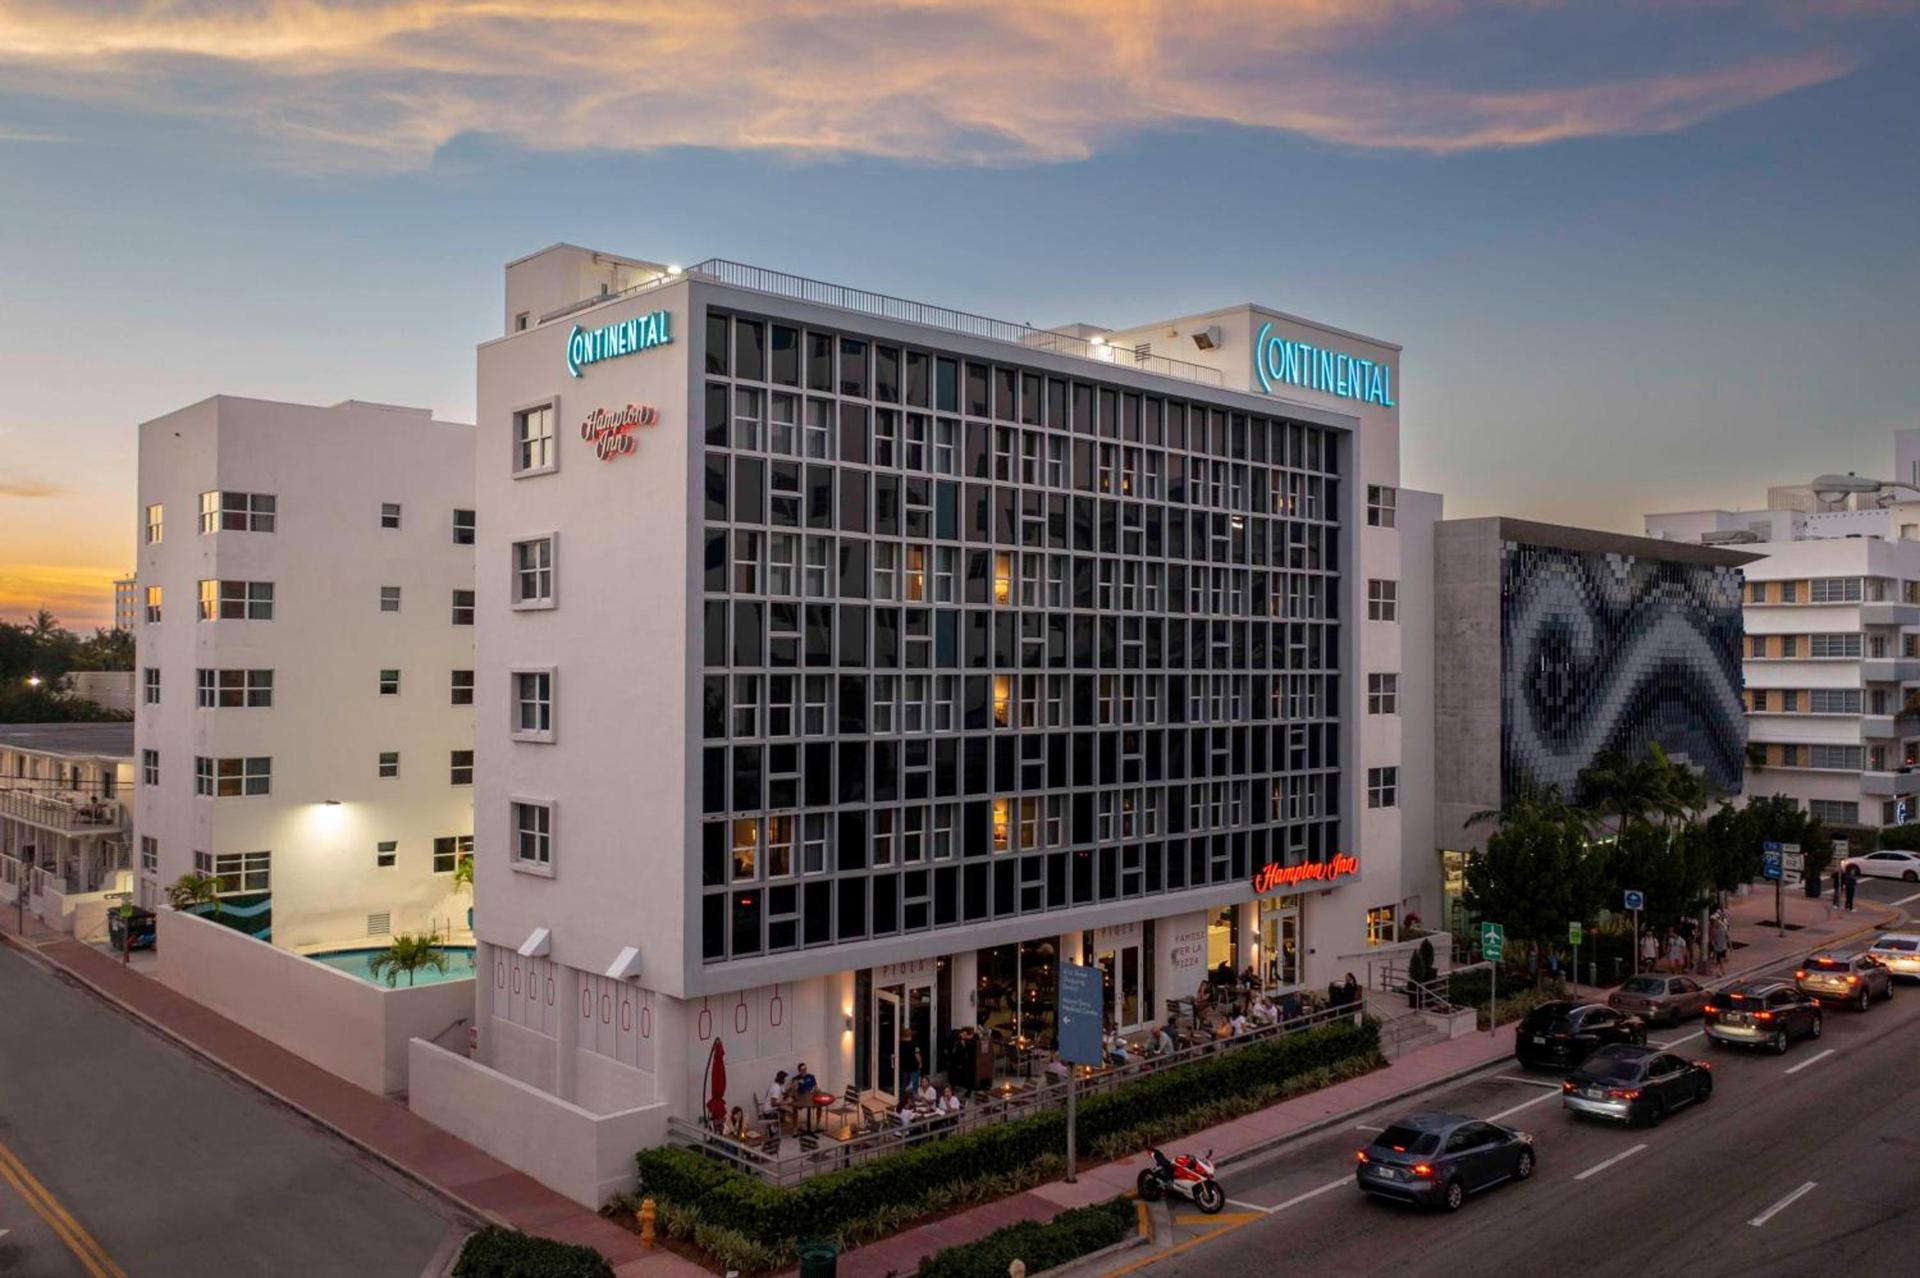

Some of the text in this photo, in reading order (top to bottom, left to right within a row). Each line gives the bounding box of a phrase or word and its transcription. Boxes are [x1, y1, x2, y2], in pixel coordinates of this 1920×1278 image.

[566, 310, 672, 377] CONTINENTAL
[1256, 322, 1395, 406] CONTINENTAL
[581, 404, 656, 441] Hampton
[596, 431, 635, 460] Inn
[1254, 852, 1360, 893] Hampton Inn
